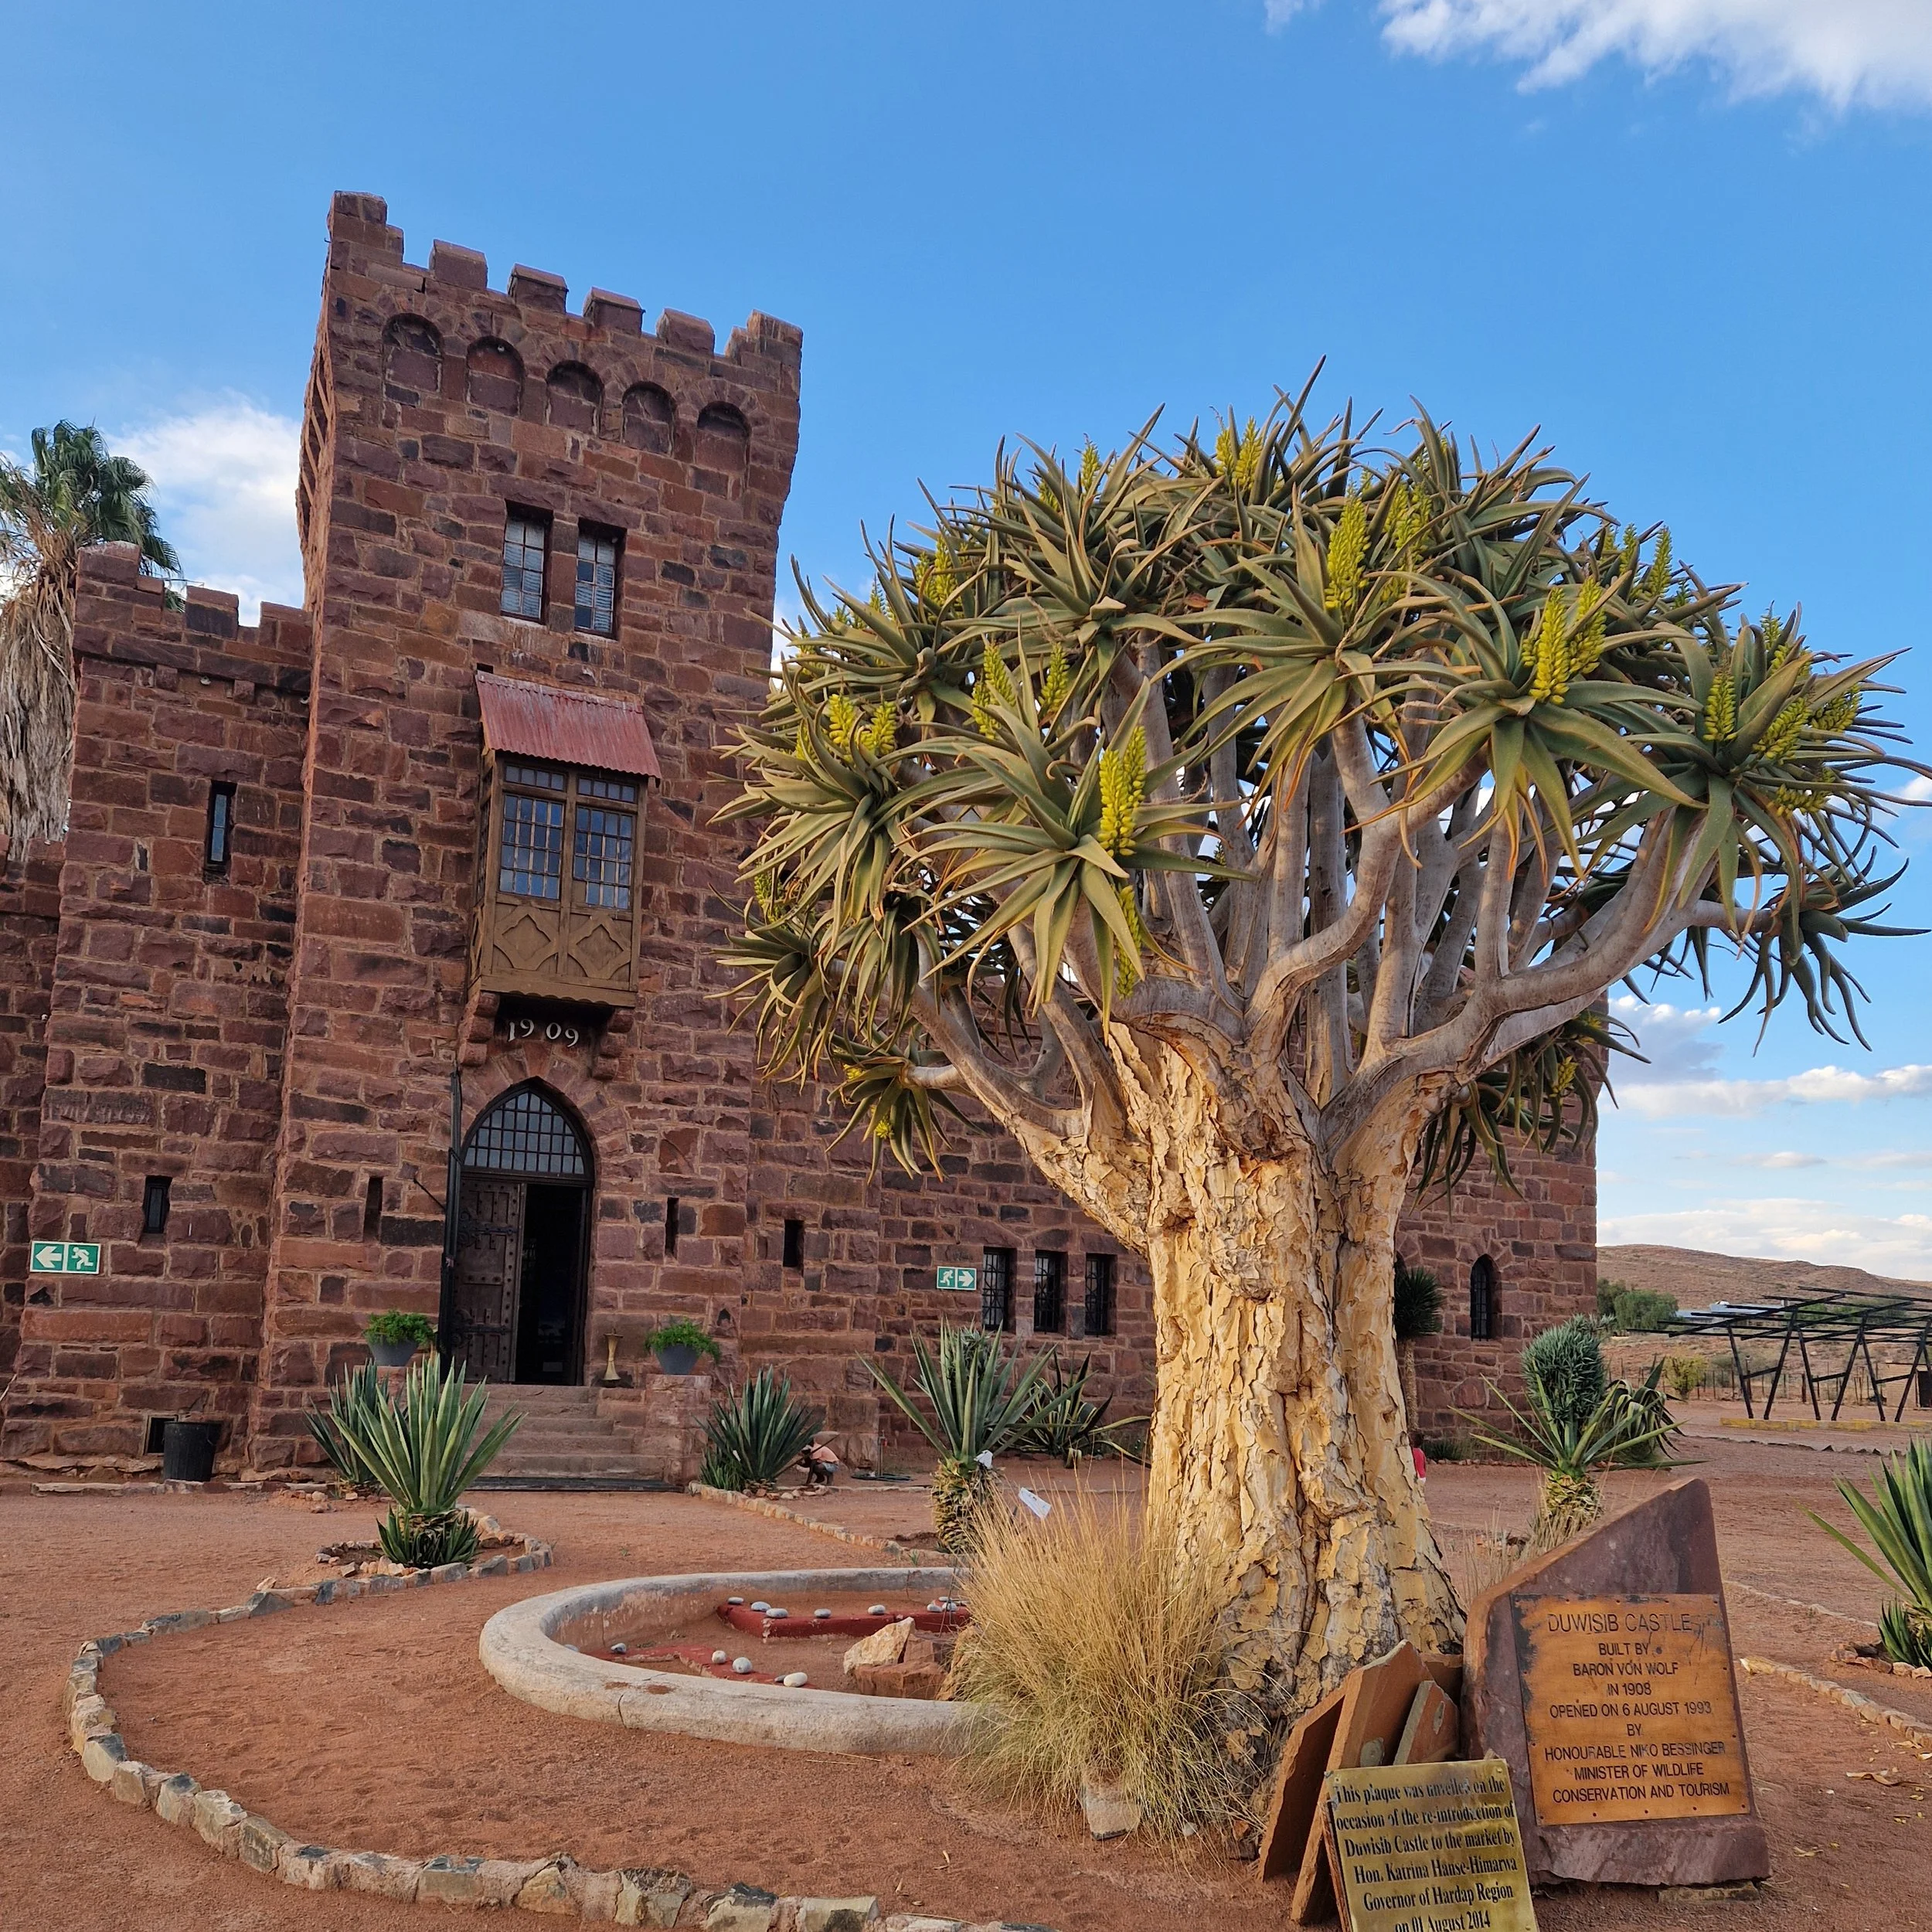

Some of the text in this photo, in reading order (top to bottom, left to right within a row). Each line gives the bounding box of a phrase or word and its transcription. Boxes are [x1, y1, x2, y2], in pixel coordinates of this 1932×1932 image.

[508, 1018, 580, 1048] 1909
[1547, 1613, 1692, 1632] DUWISIB CASTLE
[1598, 1642, 1650, 1656] BUILT BY
[1573, 1662, 1679, 1676] BARON VON WOLF
[1607, 1682, 1652, 1696] IN 1908
[1549, 1701, 1712, 1719] OPENED ON 6 AUGUST 1993
[1627, 1723, 1642, 1736] BY
[1545, 1741, 1726, 1762] HONOURABLE NIKO BESSINGER
[1573, 1762, 1705, 1781] MINISTER OF WILDLIFE
[1333, 1784, 1361, 1803] This
[1362, 1783, 1401, 1805] plaque
[1403, 1785, 1424, 1798] was
[1473, 1781, 1487, 1794] on
[1488, 1775, 1505, 1793] the
[1553, 1781, 1730, 1804] CONSERVATION AND TOURISM
[1335, 1800, 1515, 1831] occasion of the re-introduction of
[1344, 1827, 1515, 1857] Duwisib Castle to the market by
[1353, 1855, 1518, 1884] Hon. Katrina Hanse-Himarwa
[1363, 1881, 1514, 1911] Governor of Hardap Region
[1395, 1910, 1491, 1932] on 01 August 2014
